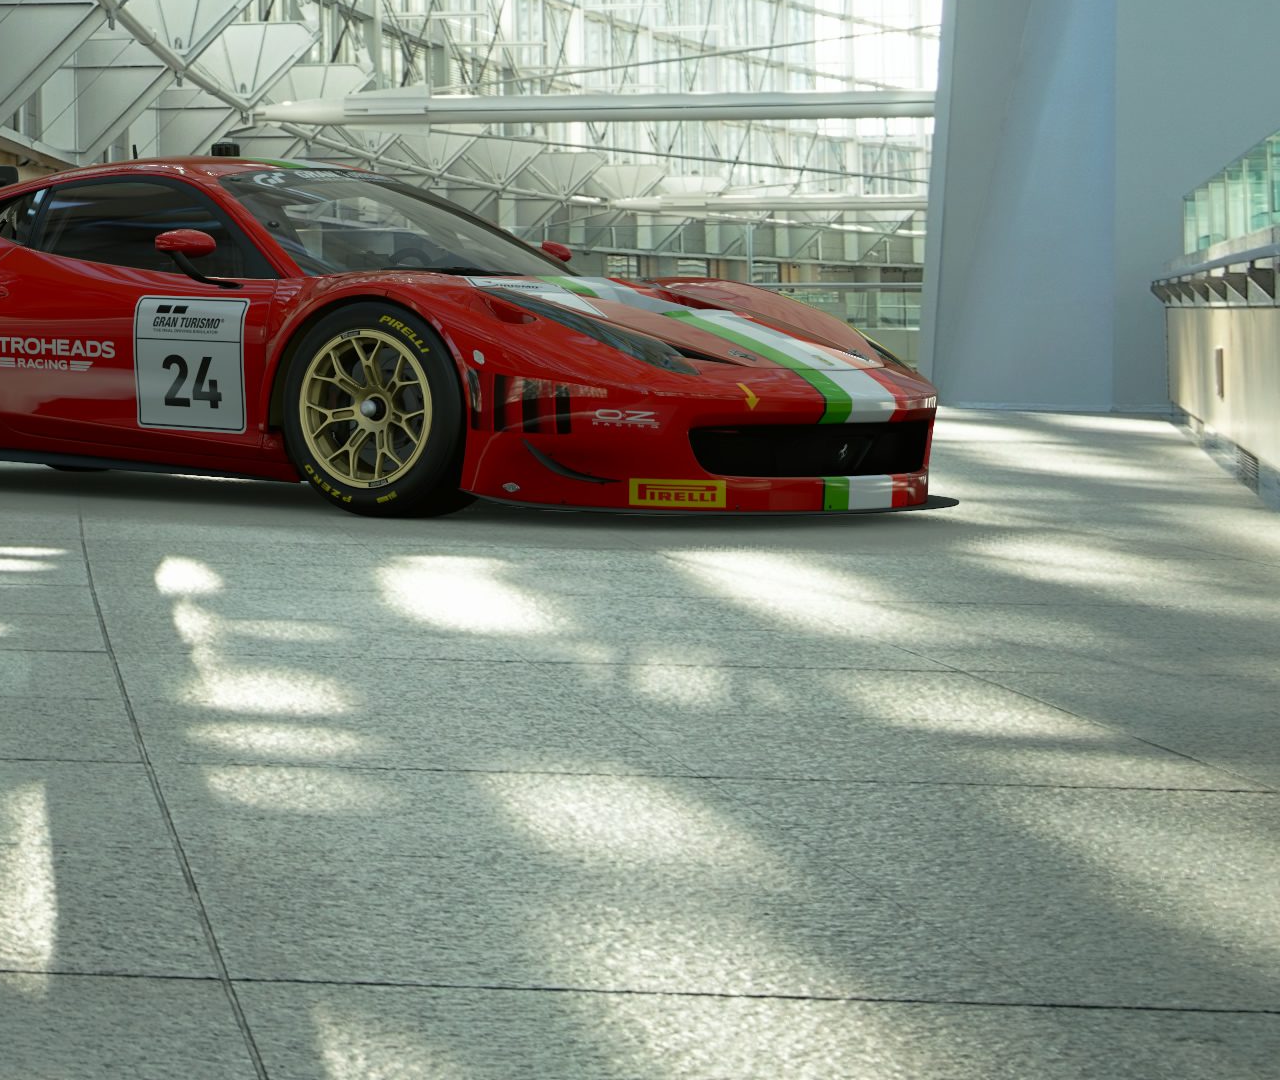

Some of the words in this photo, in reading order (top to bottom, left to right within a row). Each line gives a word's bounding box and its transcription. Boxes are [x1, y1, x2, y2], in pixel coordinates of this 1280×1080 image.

[153, 316, 179, 328] GRAN
[180, 317, 221, 329] TURISMO
[379, 315, 430, 353] PIRELLI
[17, 358, 68, 370] RACING
[162, 354, 222, 409] 24
[638, 484, 718, 502] PIRELLI
